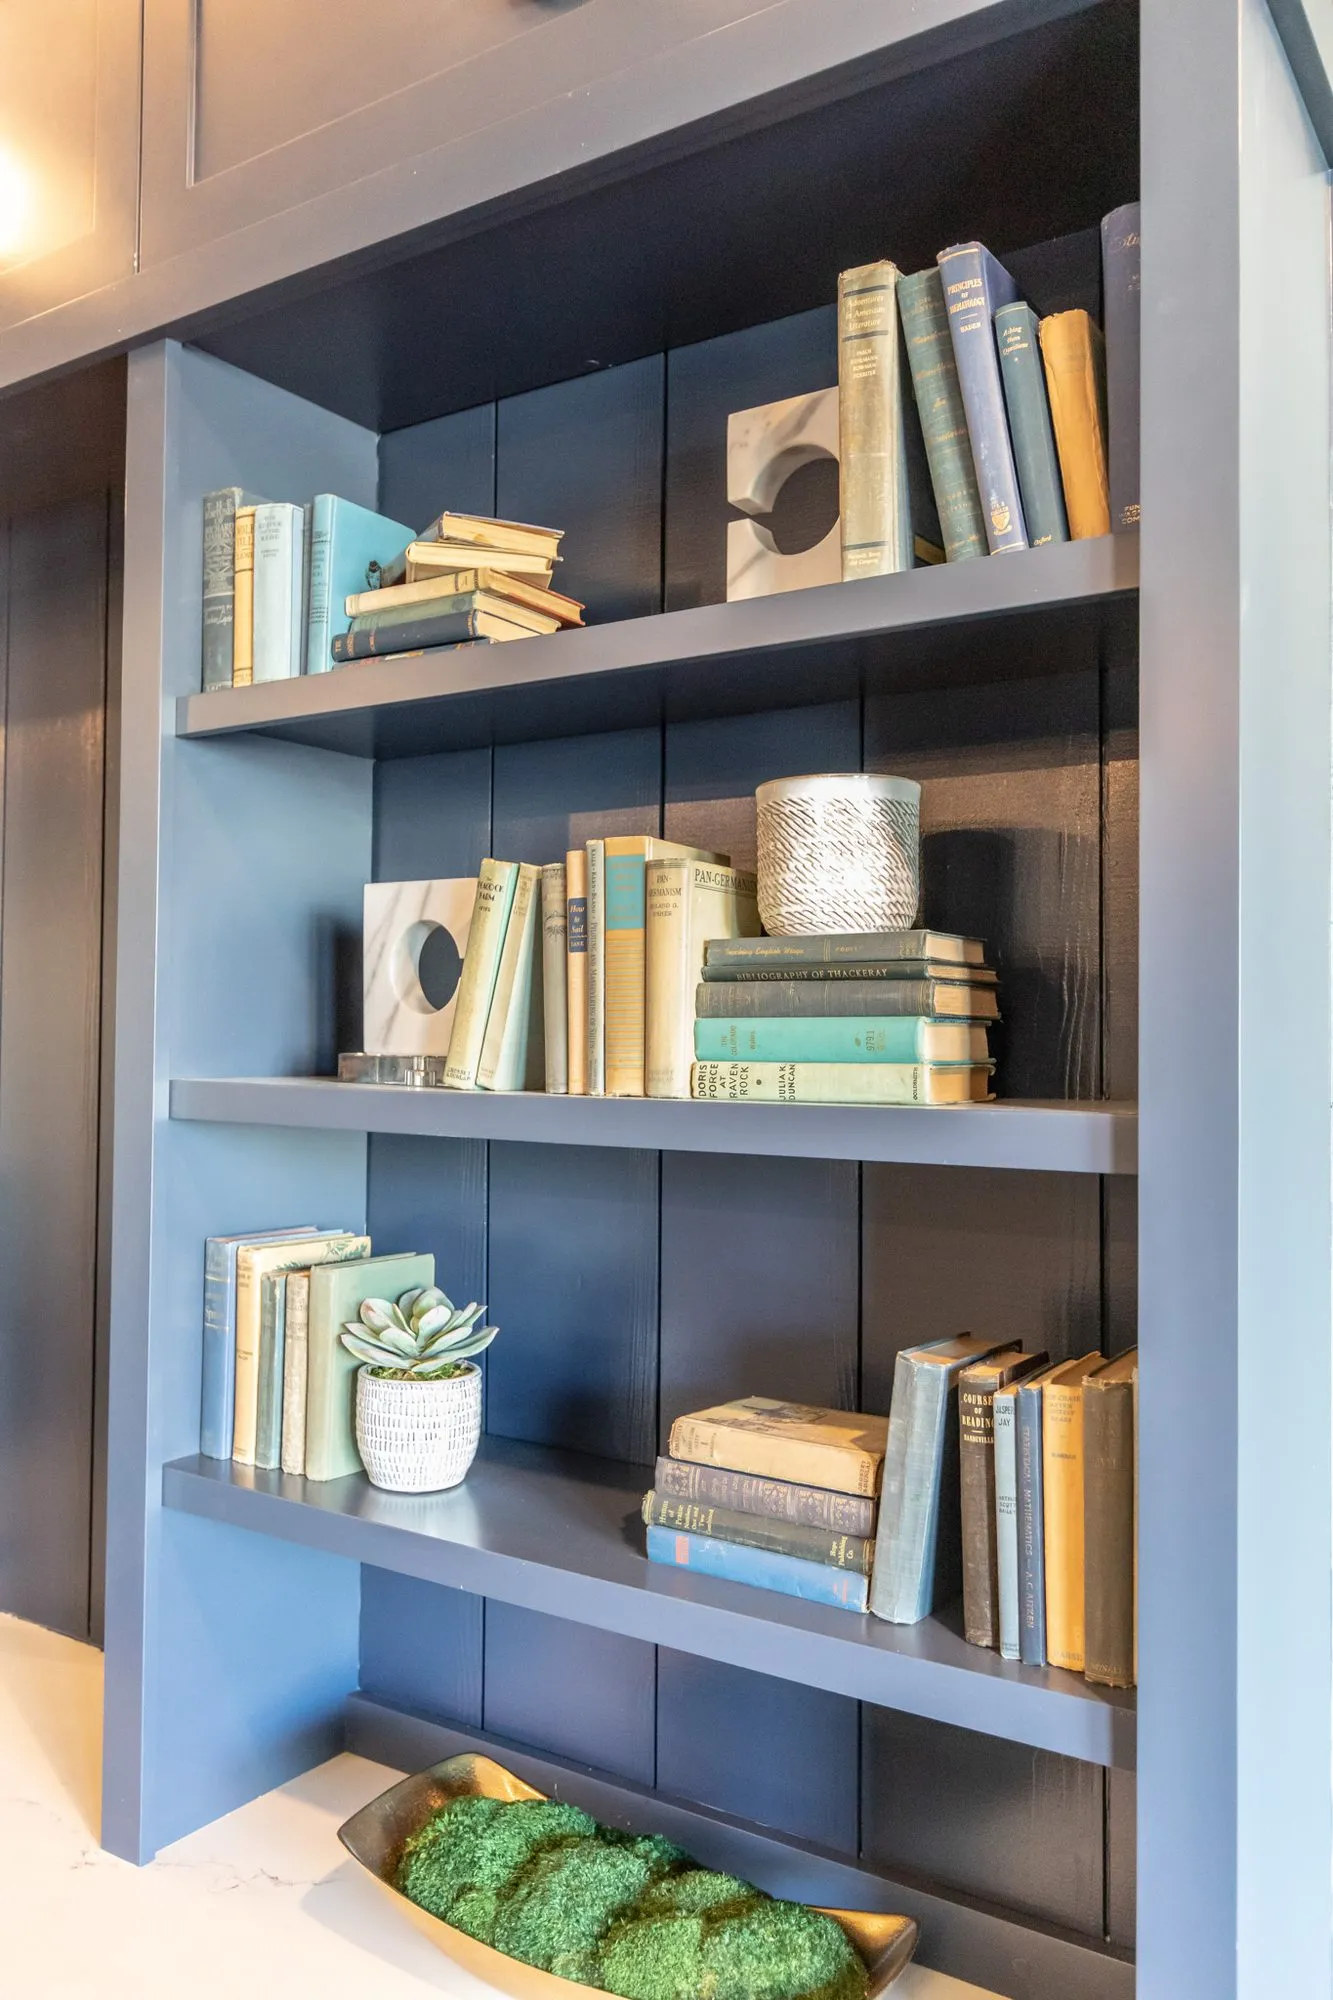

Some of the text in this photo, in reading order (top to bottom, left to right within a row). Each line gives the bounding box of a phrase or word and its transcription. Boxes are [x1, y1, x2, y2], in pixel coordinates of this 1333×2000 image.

[947, 278, 983, 295] PRINCIPLES
[848, 319, 882, 331] Literature
[569, 904, 585, 913] How
[570, 924, 585, 934] Sail
[756, 946, 781, 957] English
[736, 968, 888, 981] BIBLIOGRAPHY OF THACKERAY
[699, 1064, 707, 1097] DORIS
[710, 1063, 718, 1098] FORCE
[720, 1076, 727, 1089] AT
[729, 1063, 738, 1099] RAVEN
[740, 1066, 749, 1096] ROCK
[963, 1392, 993, 1406] COURSE
[974, 1407, 983, 1415] OF
[998, 1417, 1011, 1428] JAY
[659, 1500, 668, 1523] Hymns
[675, 1505, 684, 1525] Praise
[1024, 1488, 1033, 1557] MATHEMATICS
[1026, 1592, 1035, 1629] AITKEN
